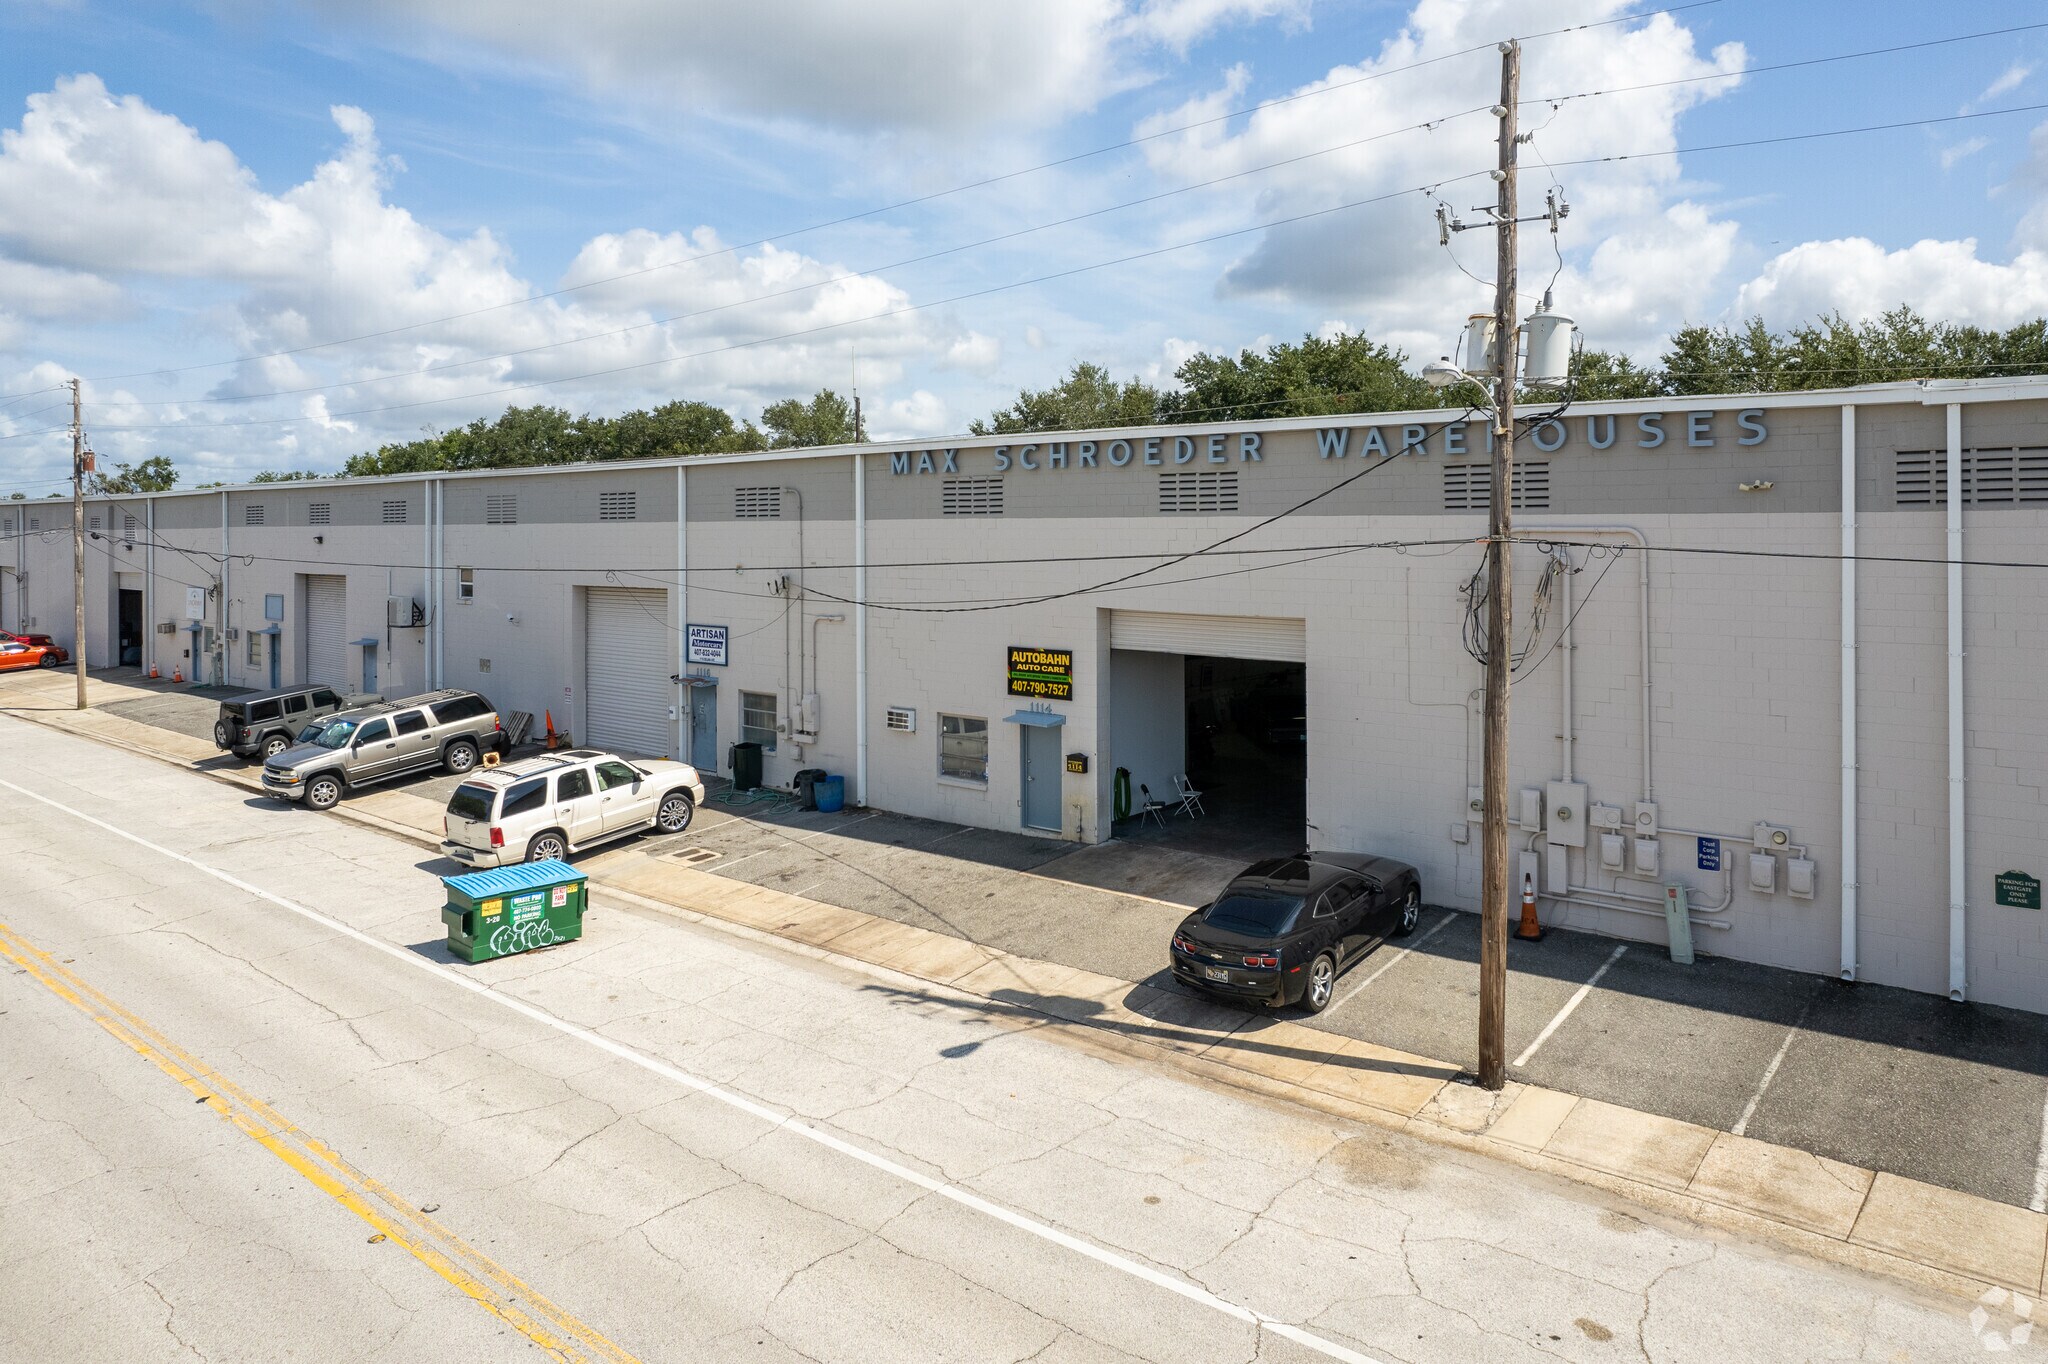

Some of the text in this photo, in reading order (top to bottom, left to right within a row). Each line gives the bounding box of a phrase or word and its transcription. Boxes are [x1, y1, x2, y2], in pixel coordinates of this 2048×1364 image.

[890, 408, 1769, 476] MAX SCHROEDER WAREOUSES
[691, 628, 724, 640] ARTISAN
[693, 640, 722, 648] Motorcars
[1012, 652, 1070, 666] AUTOBAHN
[1041, 665, 1065, 673] CARE
[1012, 680, 1069, 696] 407-790-7527
[1031, 701, 1052, 714] 1114
[1997, 878, 2024, 886] PARKING
